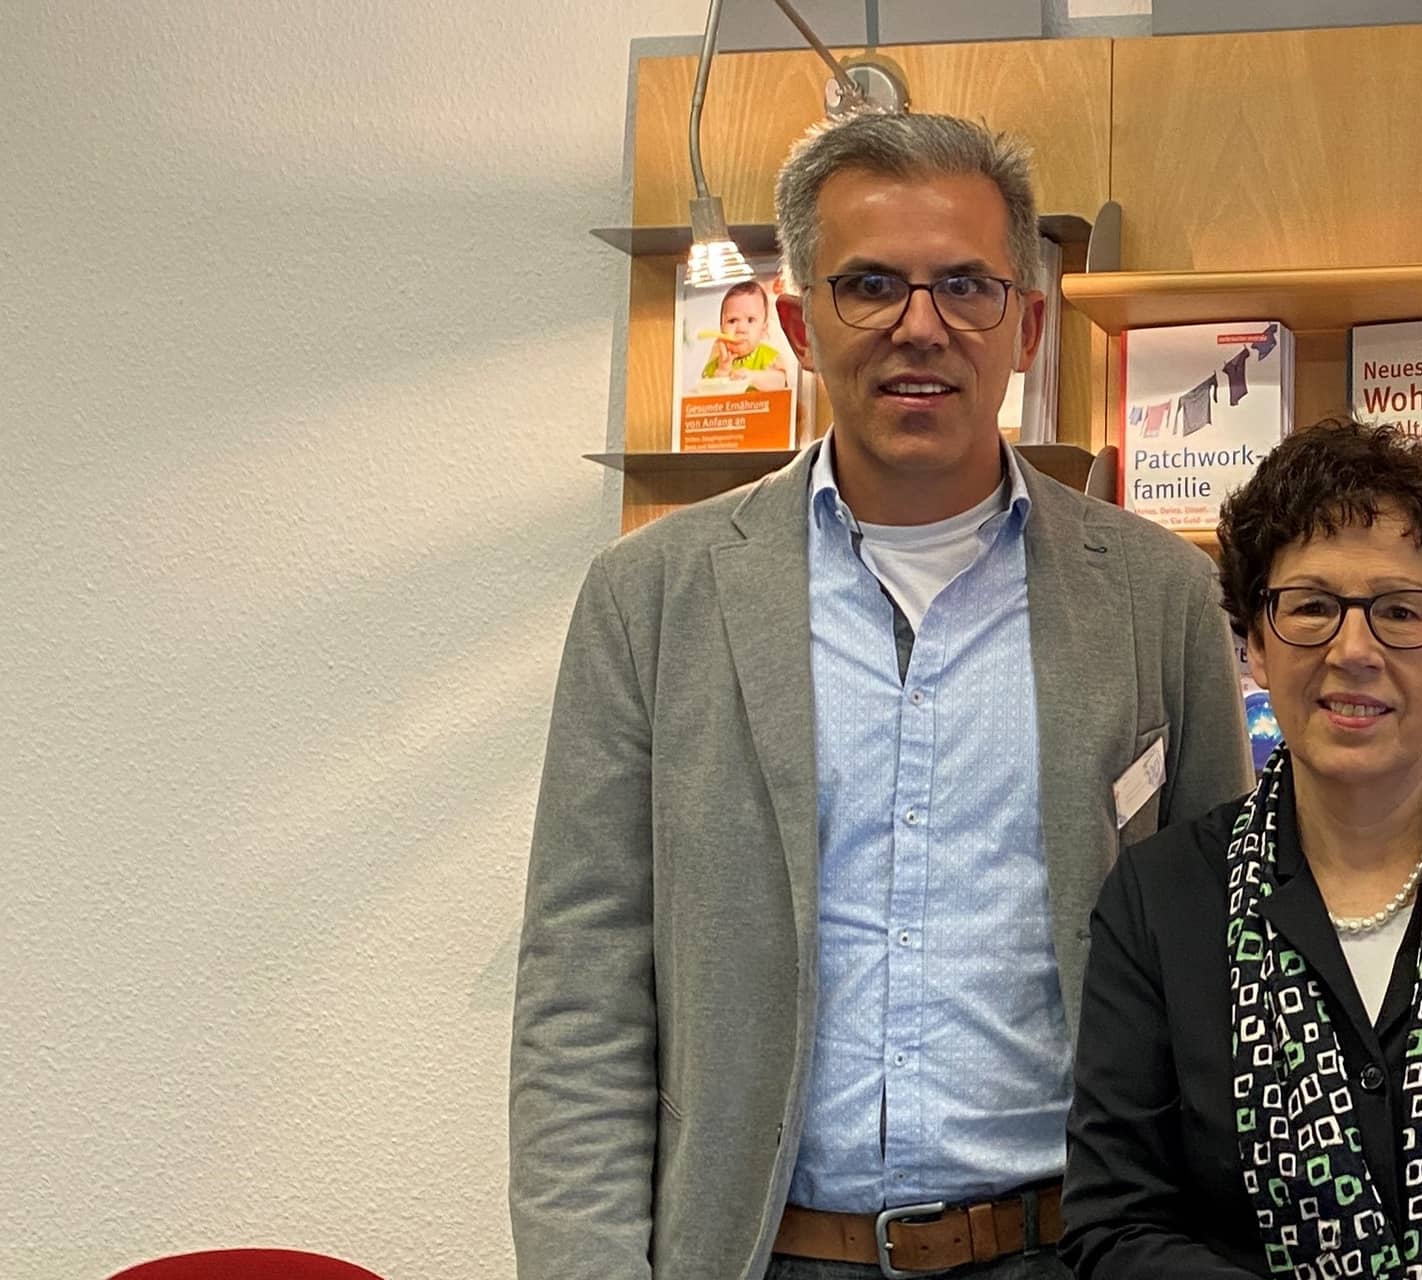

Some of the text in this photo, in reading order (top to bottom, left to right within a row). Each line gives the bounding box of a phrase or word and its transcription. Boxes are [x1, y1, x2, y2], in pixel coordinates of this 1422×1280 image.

[685, 399, 769, 416] Gesunde Ernährung
[685, 419, 701, 430] von
[702, 416, 733, 429] Anfang
[1135, 444, 1265, 470] Patchwork-
[1134, 476, 1211, 500] familie
